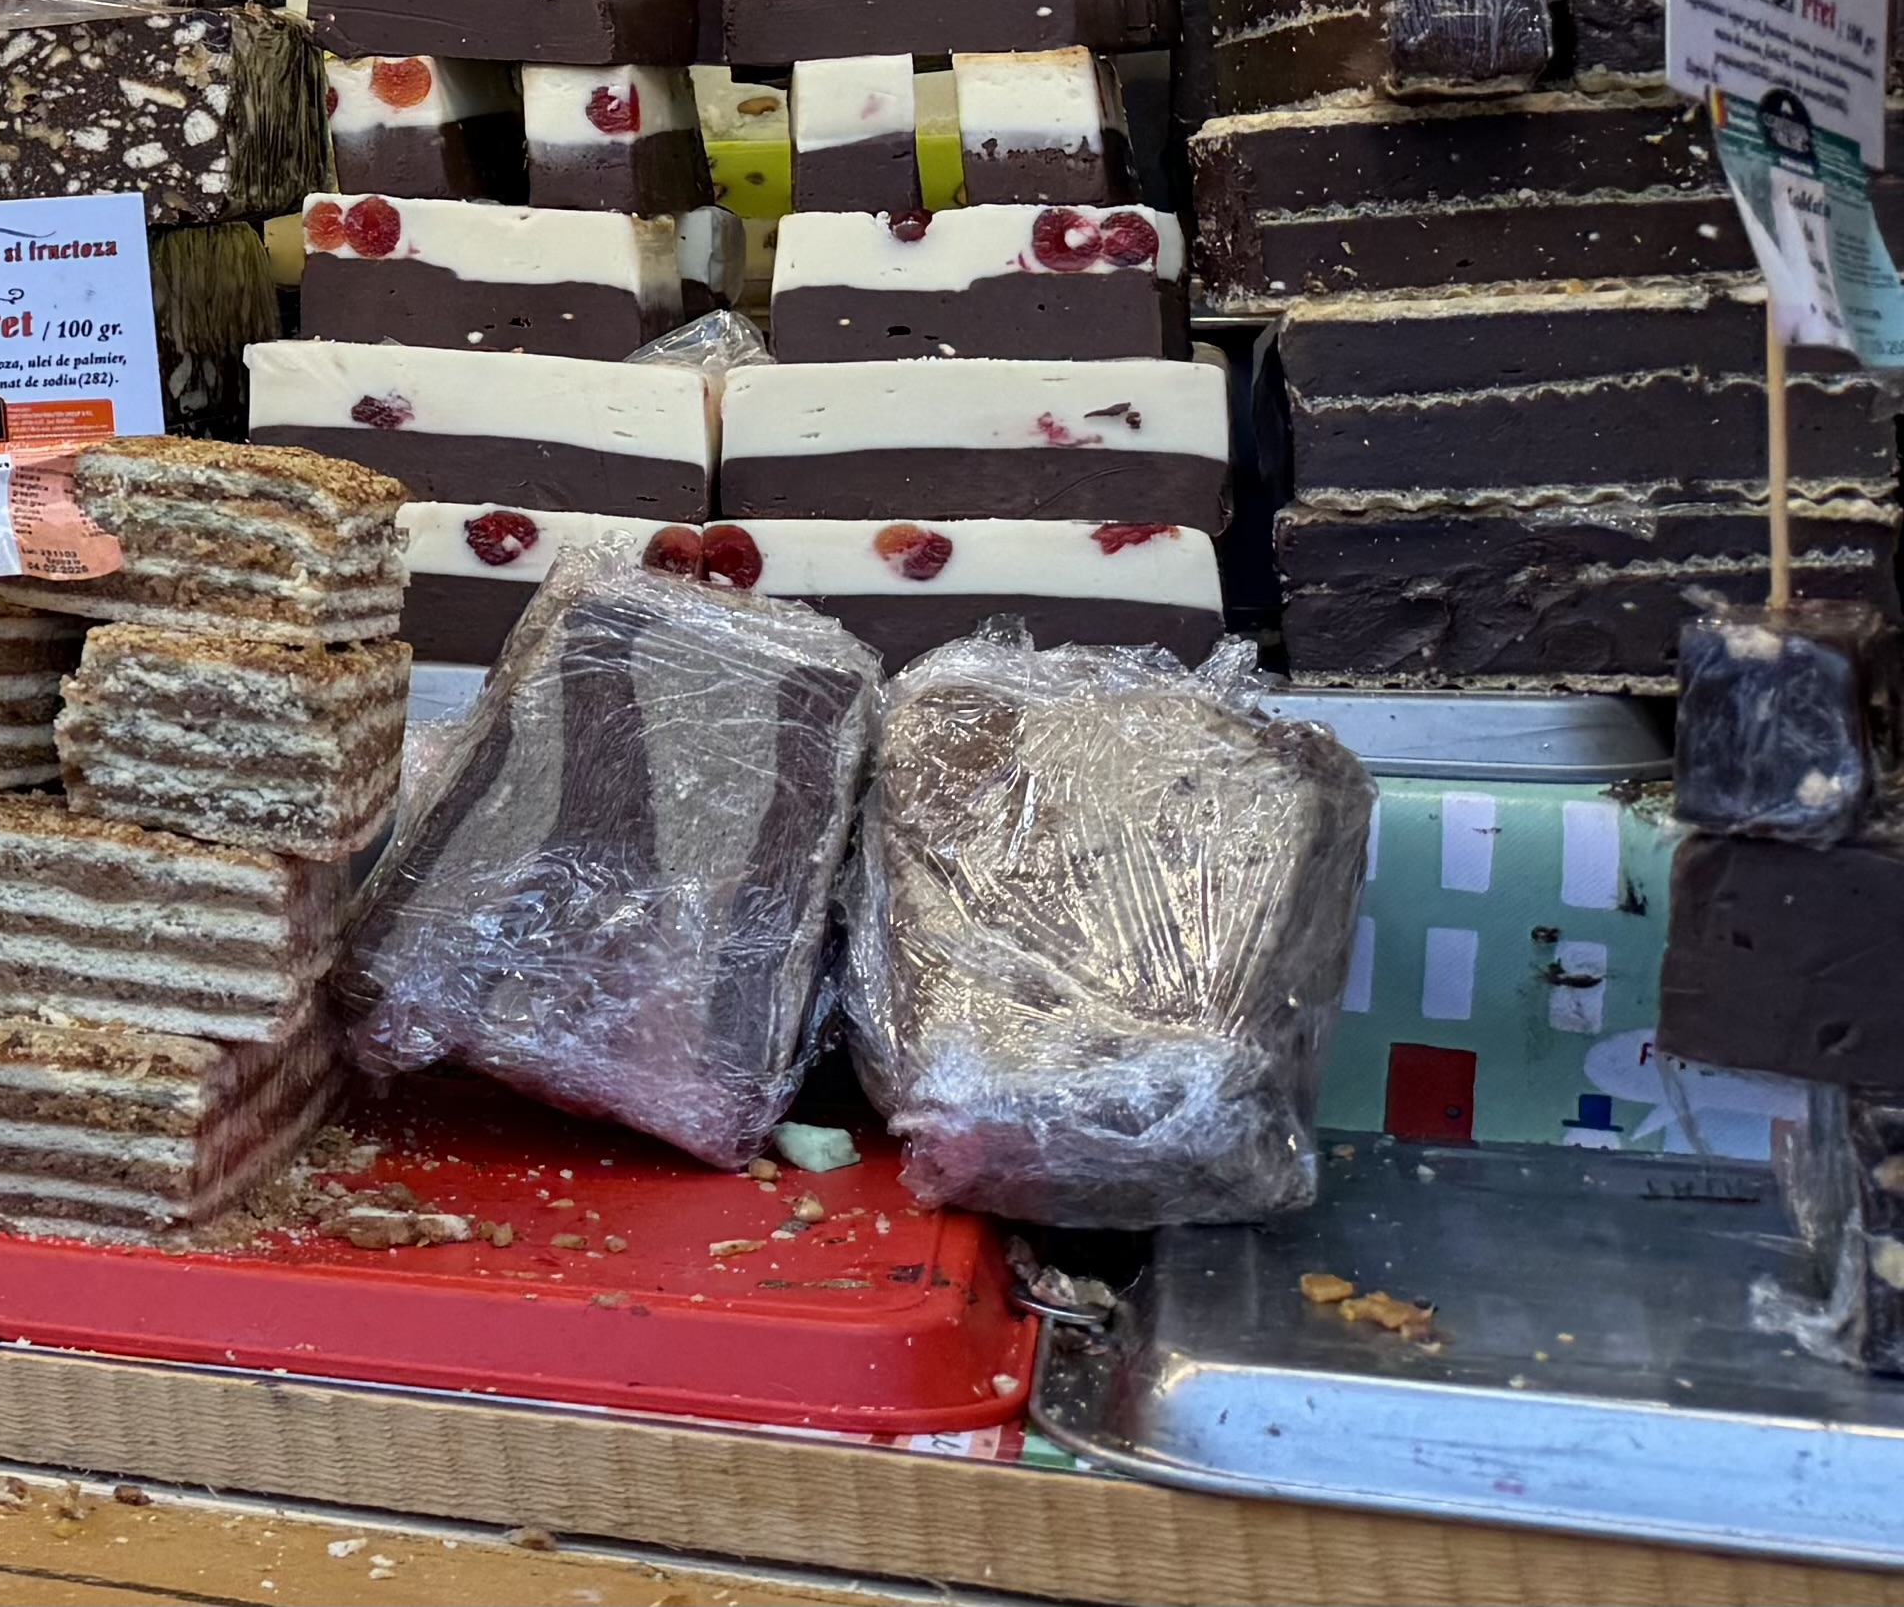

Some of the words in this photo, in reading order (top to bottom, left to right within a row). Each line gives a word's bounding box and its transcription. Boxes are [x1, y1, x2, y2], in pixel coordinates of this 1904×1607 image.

[4, 241, 23, 262] si
[29, 240, 118, 261] fructoza
[57, 319, 92, 339] 100
[97, 322, 123, 342] gr.
[28, 355, 52, 368] ulei
[56, 354, 70, 367] de
[73, 352, 127, 369] palmier,
[24, 375, 40, 389] de
